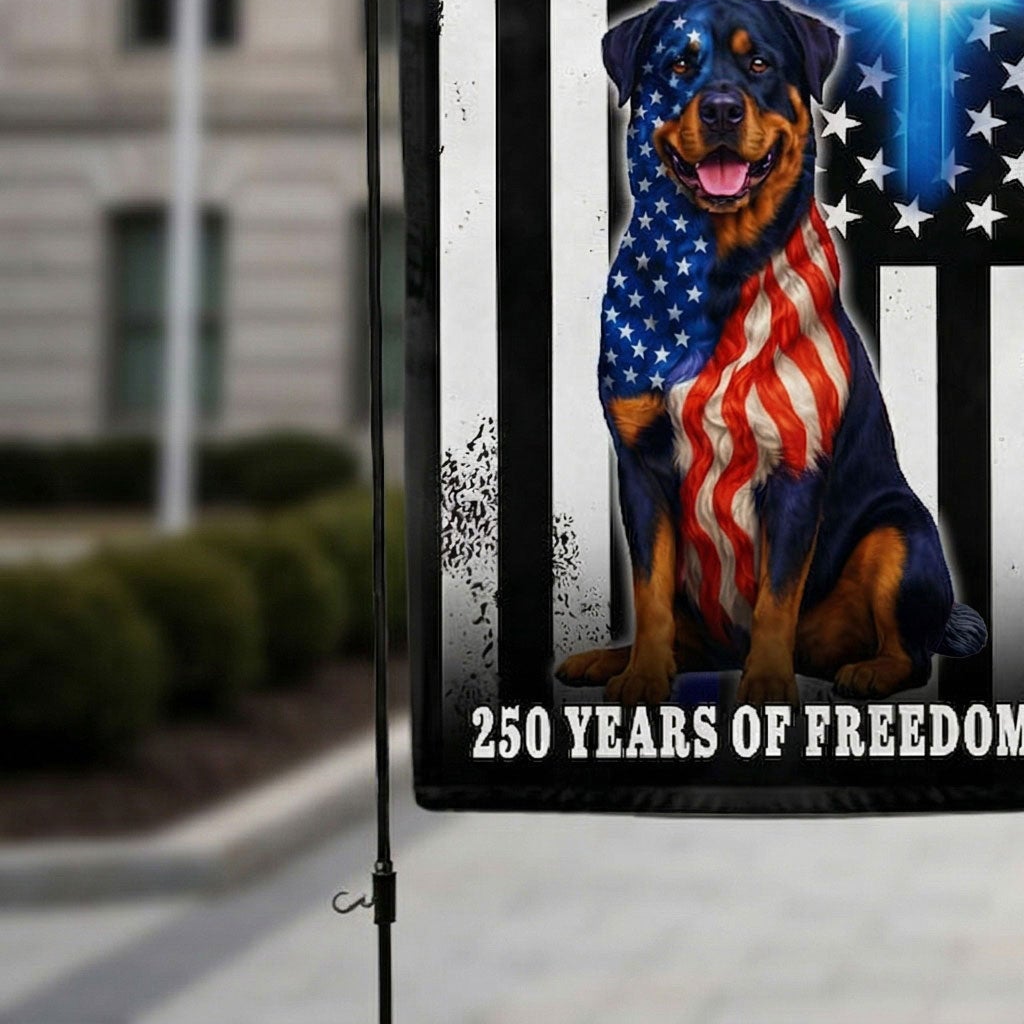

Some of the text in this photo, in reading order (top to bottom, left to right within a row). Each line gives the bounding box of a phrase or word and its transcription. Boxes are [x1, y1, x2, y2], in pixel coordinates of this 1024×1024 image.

[471, 705, 551, 759] 250
[564, 705, 719, 759] YEARS
[732, 705, 791, 759] OF
